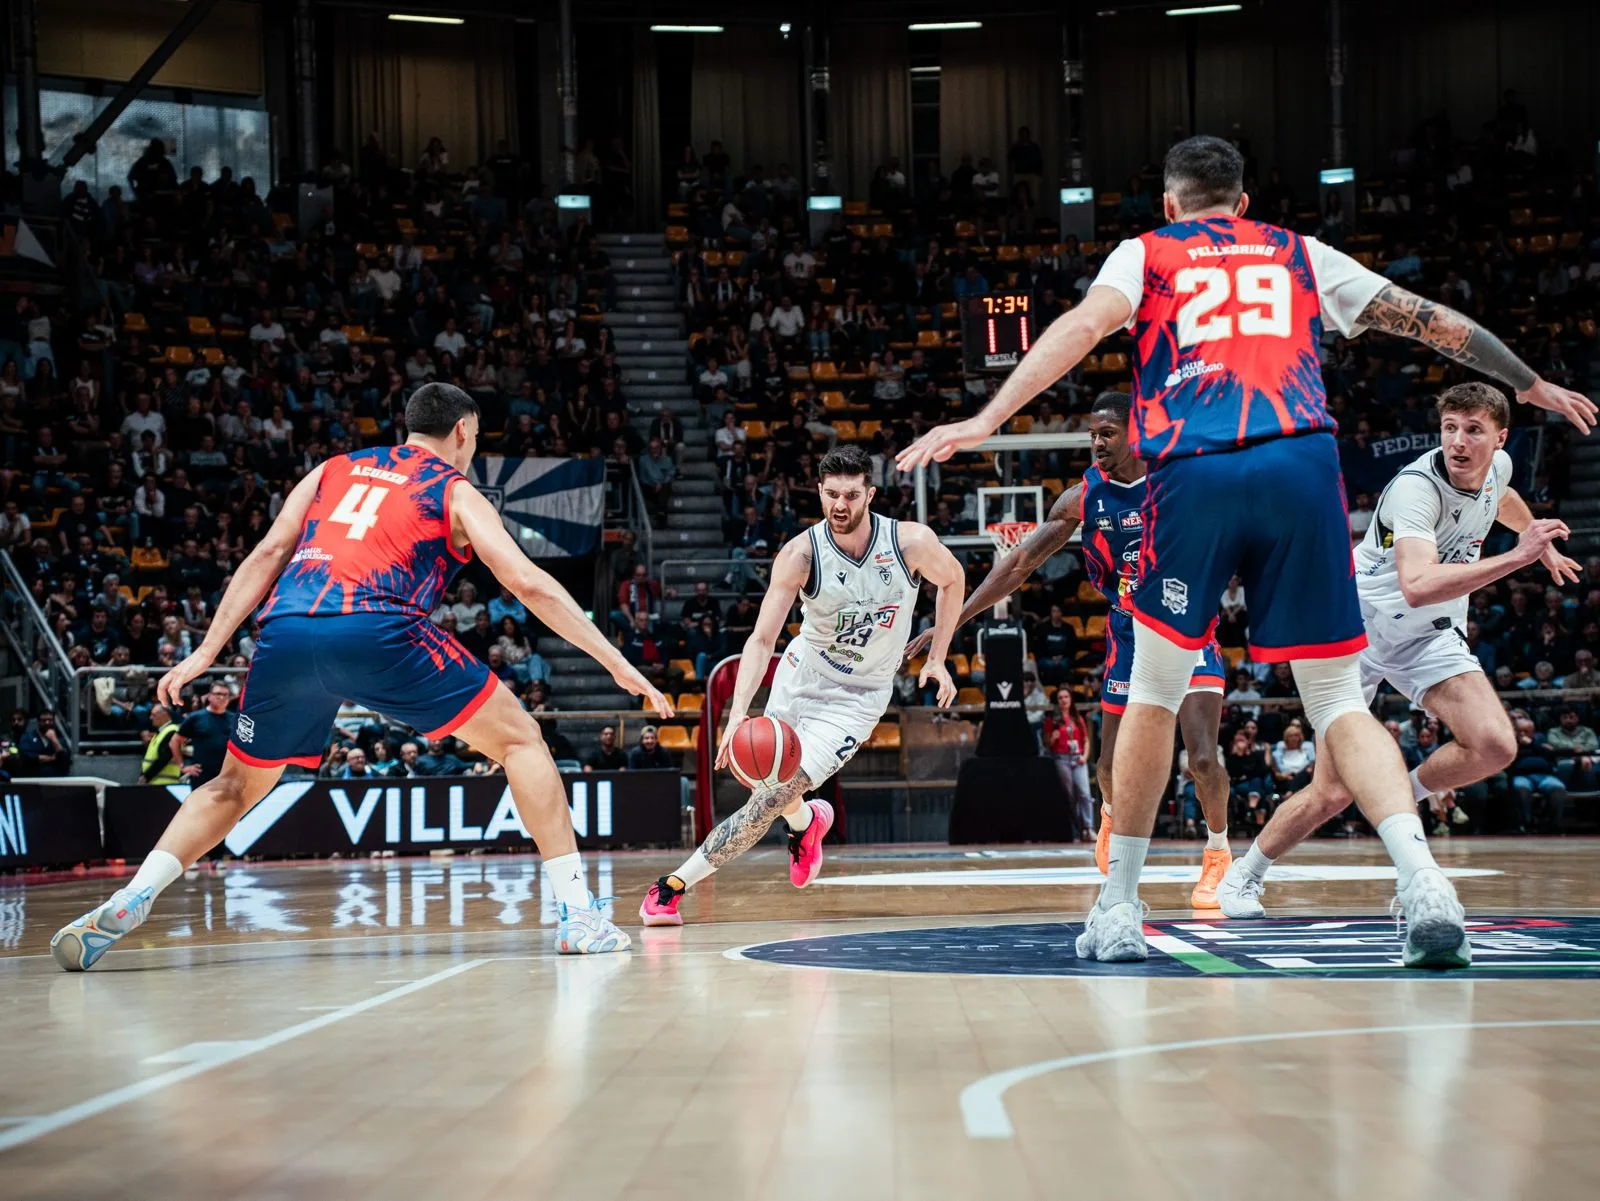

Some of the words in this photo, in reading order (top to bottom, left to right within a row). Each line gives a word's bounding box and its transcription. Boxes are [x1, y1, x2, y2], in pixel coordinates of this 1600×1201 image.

[1186, 244, 1276, 262] PELLEGRINO
[983, 295, 1028, 314] 7:34
[1174, 263, 1292, 350] 29
[1371, 433, 1441, 458] FEDELI
[349, 465, 408, 485] ACUNZO
[328, 483, 389, 541] 4
[1097, 499, 1105, 512] 1
[1121, 516, 1143, 528] NER
[1122, 551, 1140, 562] GE
[835, 735, 861, 762] 2
